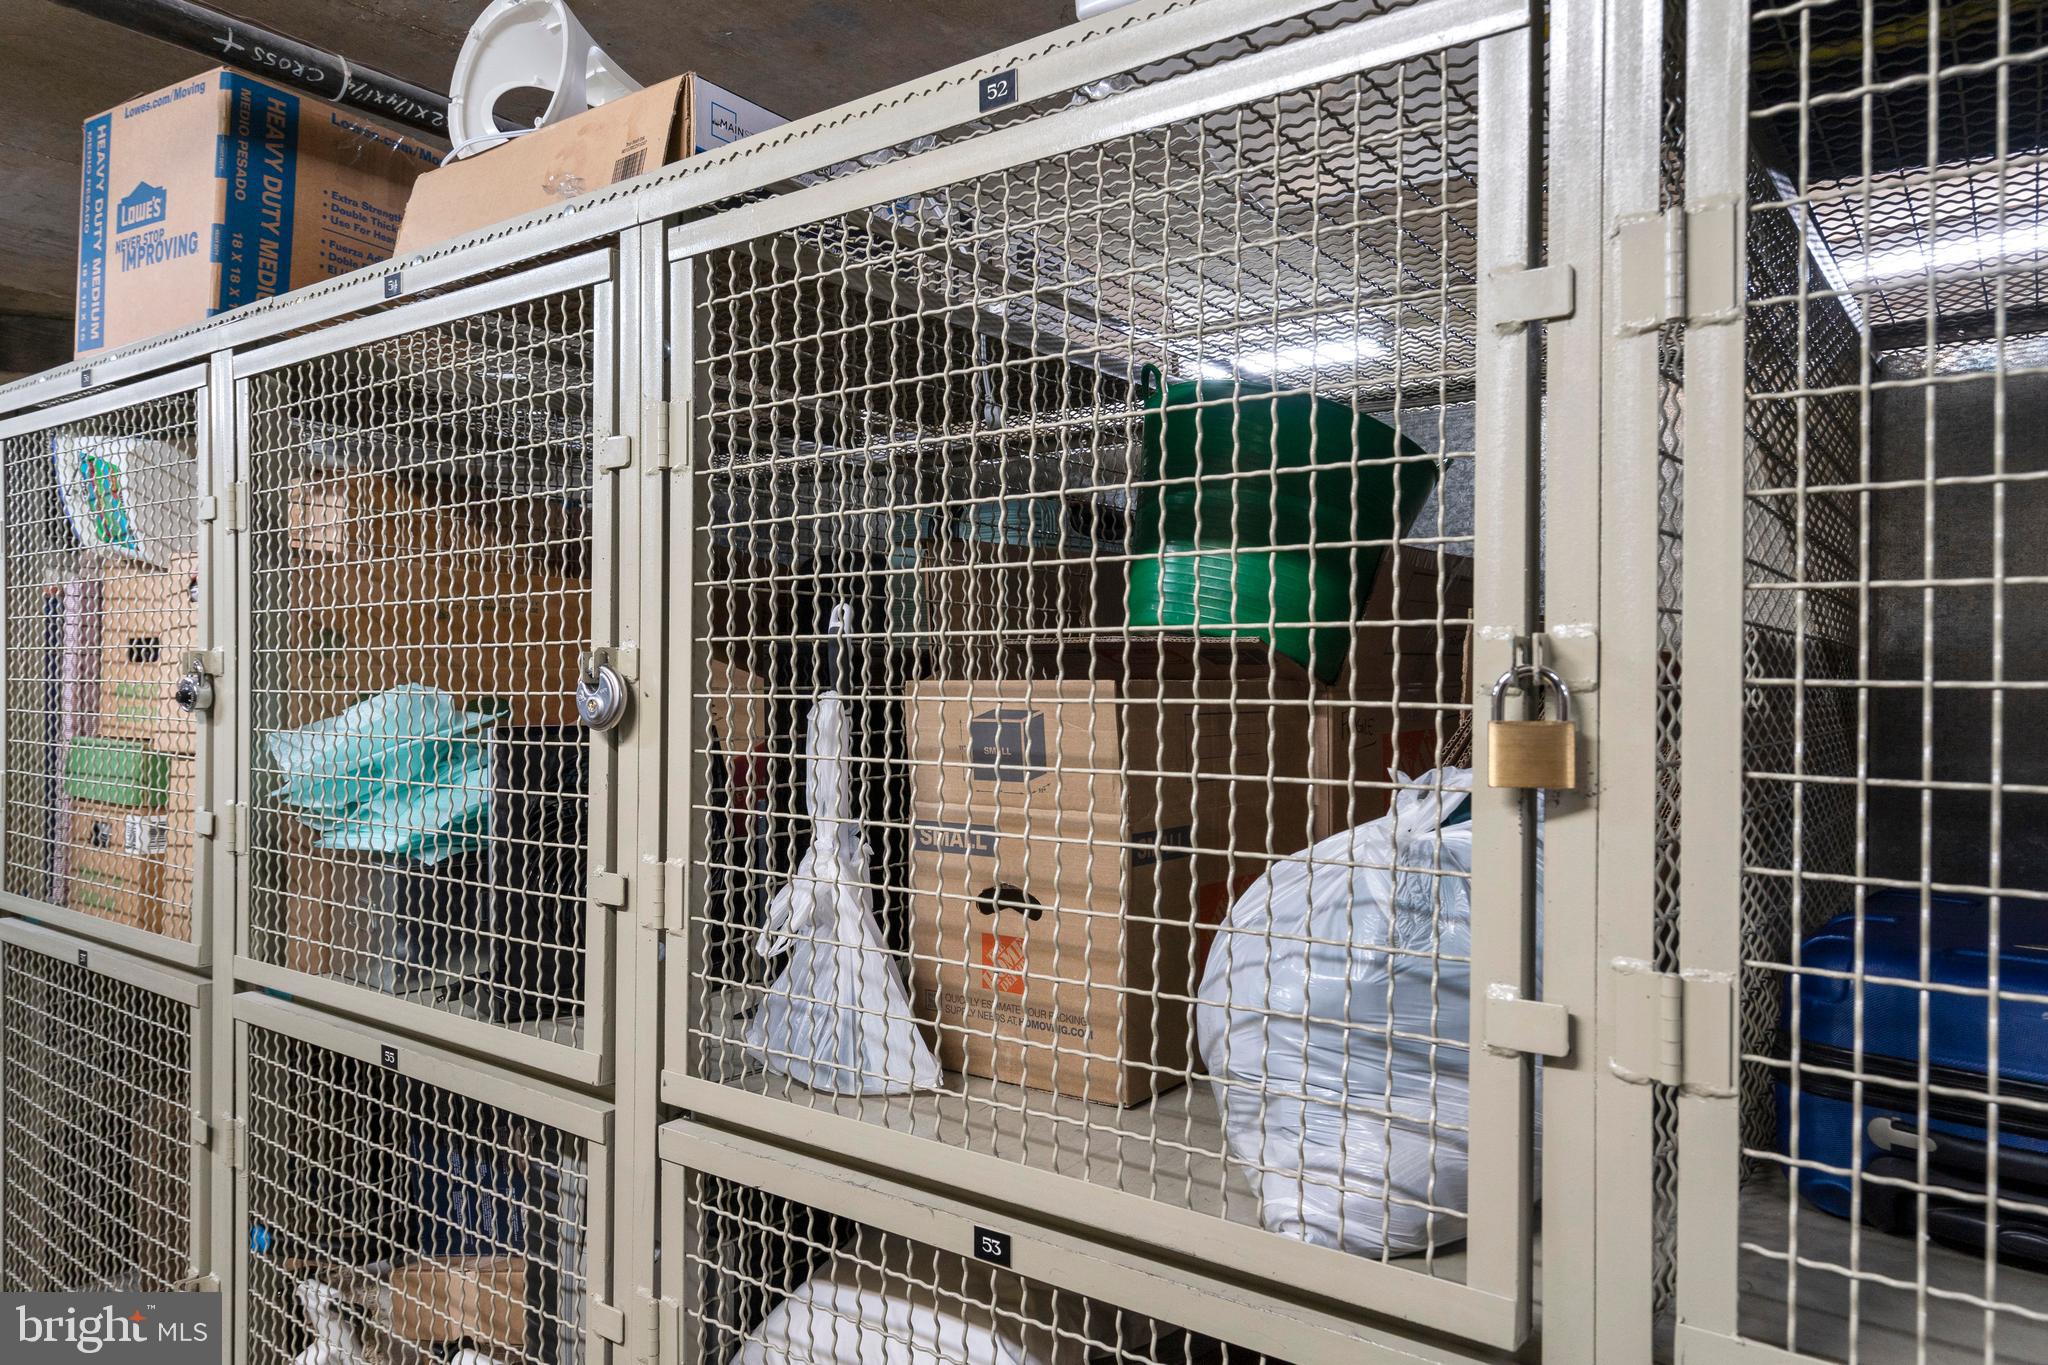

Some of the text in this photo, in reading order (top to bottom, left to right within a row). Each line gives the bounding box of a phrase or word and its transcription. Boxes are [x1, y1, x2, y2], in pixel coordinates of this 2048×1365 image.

[252, 46, 325, 82] CROSS
[987, 80, 1008, 100] 52
[124, 82, 206, 119] Lowes.com/Moving
[264, 96, 287, 173] HEAVY
[720, 118, 754, 138] MAINS
[234, 87, 252, 201] MEDIO PESADO
[84, 179, 92, 234] PESADO
[261, 174, 283, 237] DUTY
[331, 191, 358, 207] Extra
[121, 196, 161, 227] LOWE'S
[330, 203, 368, 222] Double
[90, 124, 107, 340] HEAVY DUTY MEDIUM
[329, 215, 350, 229] Use
[353, 223, 371, 235] For
[115, 228, 165, 255] NEVER STOP
[232, 232, 243, 248] 18
[122, 231, 199, 273] IMPROVING
[231, 251, 242, 262] X
[328, 252, 358, 268] Doble
[229, 267, 241, 283] 18
[228, 287, 240, 297] X
[983, 746, 1012, 755] SMLL
[944, 993, 980, 1007] QUICLY
[981, 999, 1021, 1015] ESMATE
[1023, 1007, 1047, 1020] OUR
[977, 1010, 1005, 1024] NEES
[1018, 1018, 1094, 1040] HDMOVIG.CO
[384, 1051, 395, 1064] 55
[982, 1236, 1002, 1256] 53
